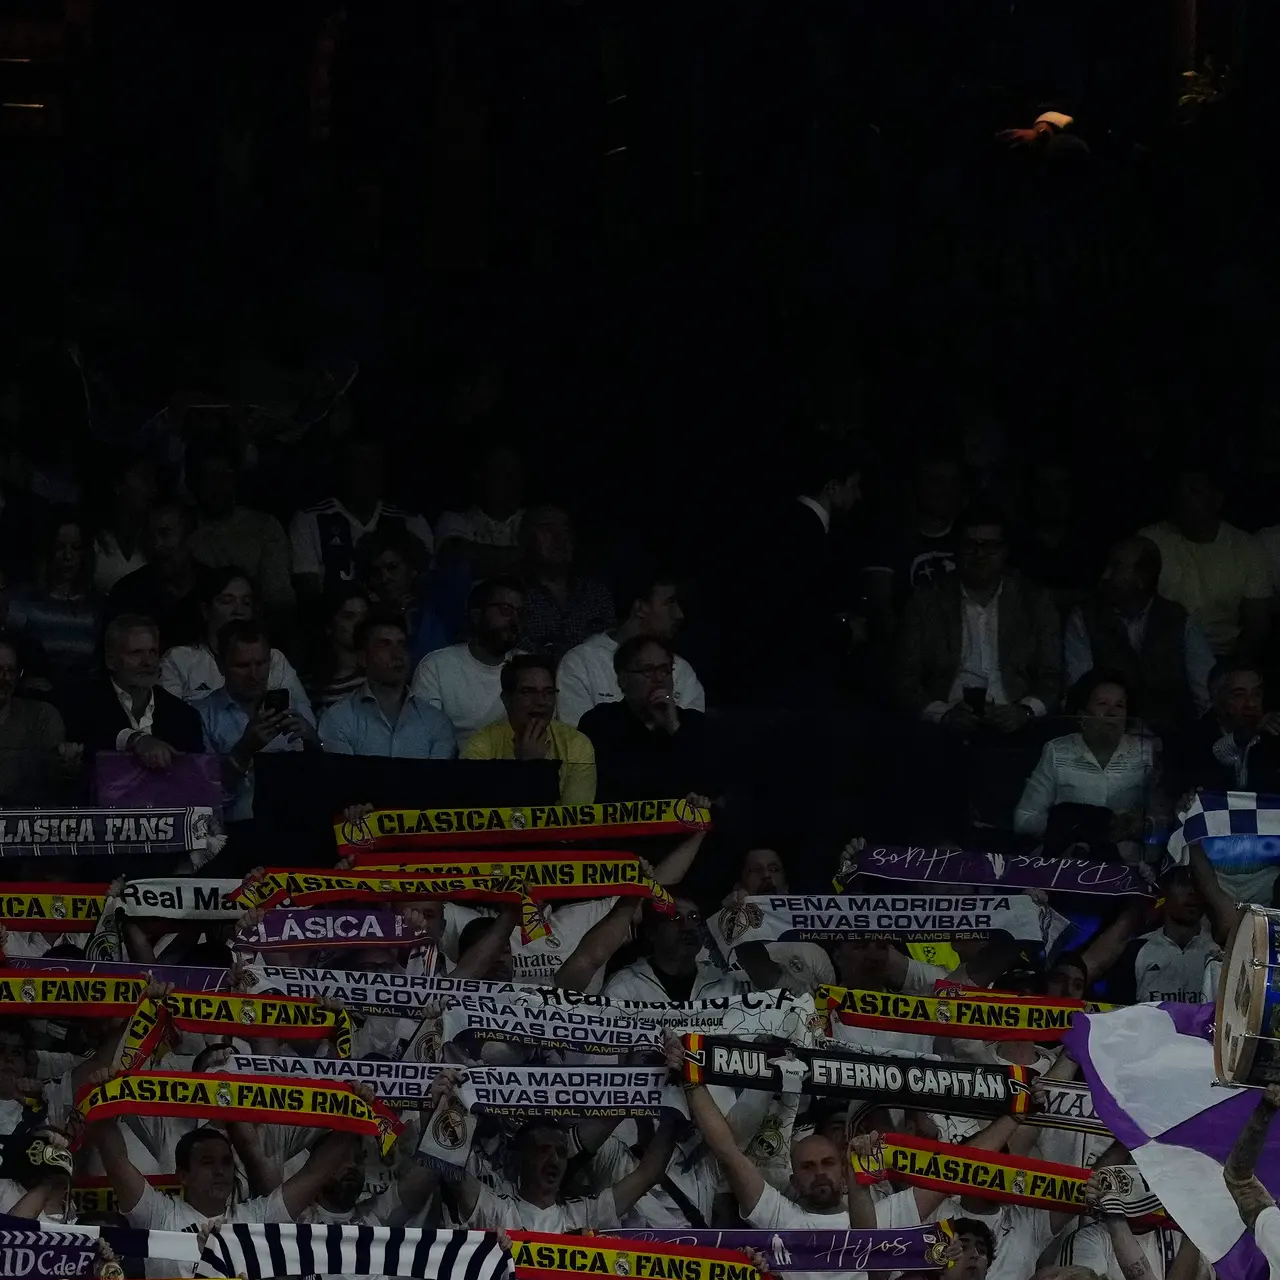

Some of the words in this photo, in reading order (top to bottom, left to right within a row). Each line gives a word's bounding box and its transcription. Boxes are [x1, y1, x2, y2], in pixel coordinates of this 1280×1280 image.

[531, 803, 595, 827] FANS
[601, 800, 671, 825] RMCF
[105, 816, 175, 842] FANS
[125, 883, 184, 912] Real
[771, 895, 840, 912] PEÑA
[846, 896, 1011, 911] MADRIDISTA
[791, 914, 870, 930] RIVAS
[876, 913, 992, 930] COVIBAR
[846, 931, 860, 941] EL
[907, 931, 951, 941] VAMOS
[345, 970, 516, 995] MADRIDISTA
[712, 1047, 772, 1078] RAUL
[812, 1058, 903, 1092] ETERNO
[907, 1065, 1007, 1101] CAPITÁN
[475, 1088, 537, 1105] RIVAS
[541, 1088, 662, 1106] COVIBAR
[582, 1106, 622, 1118] VAMOS
